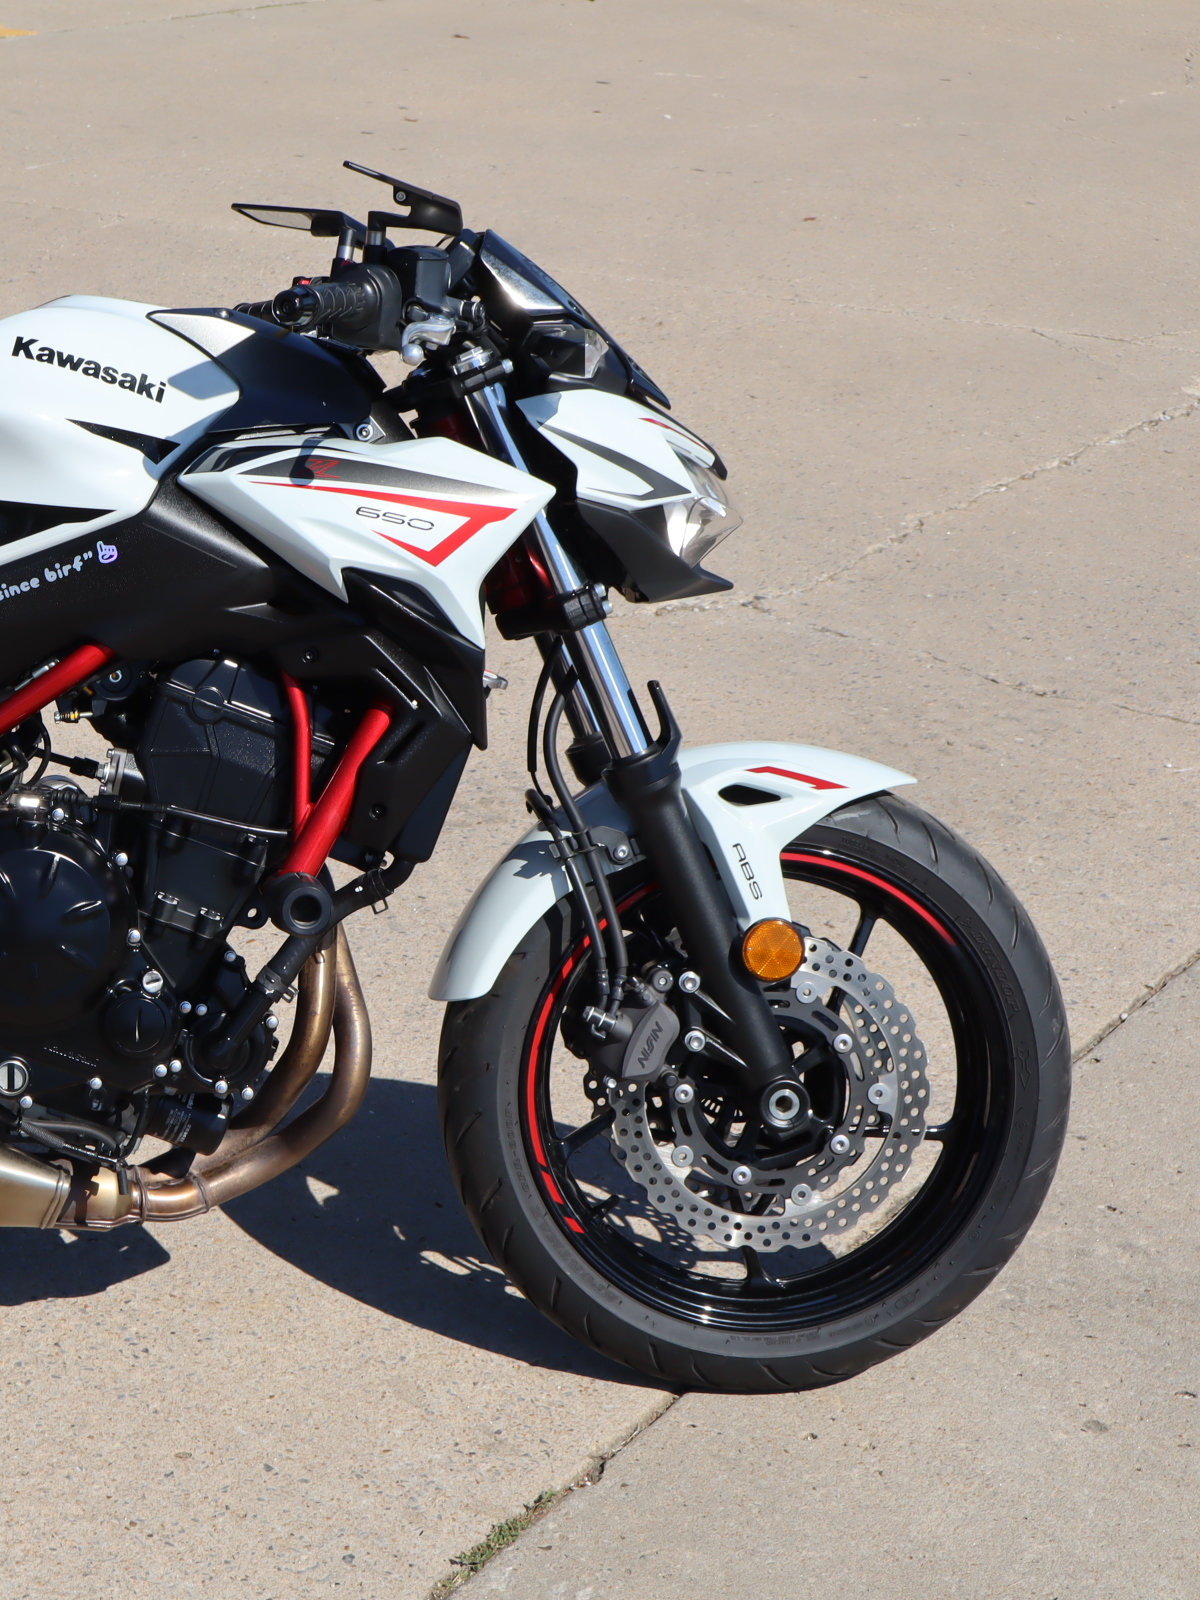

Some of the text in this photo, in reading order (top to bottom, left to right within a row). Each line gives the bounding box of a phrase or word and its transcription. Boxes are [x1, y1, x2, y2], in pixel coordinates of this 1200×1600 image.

[11, 336, 166, 403] Kawasaki
[355, 506, 435, 531] 650
[732, 843, 763, 900] ABS
[969, 927, 1020, 1012] DUNLOP
